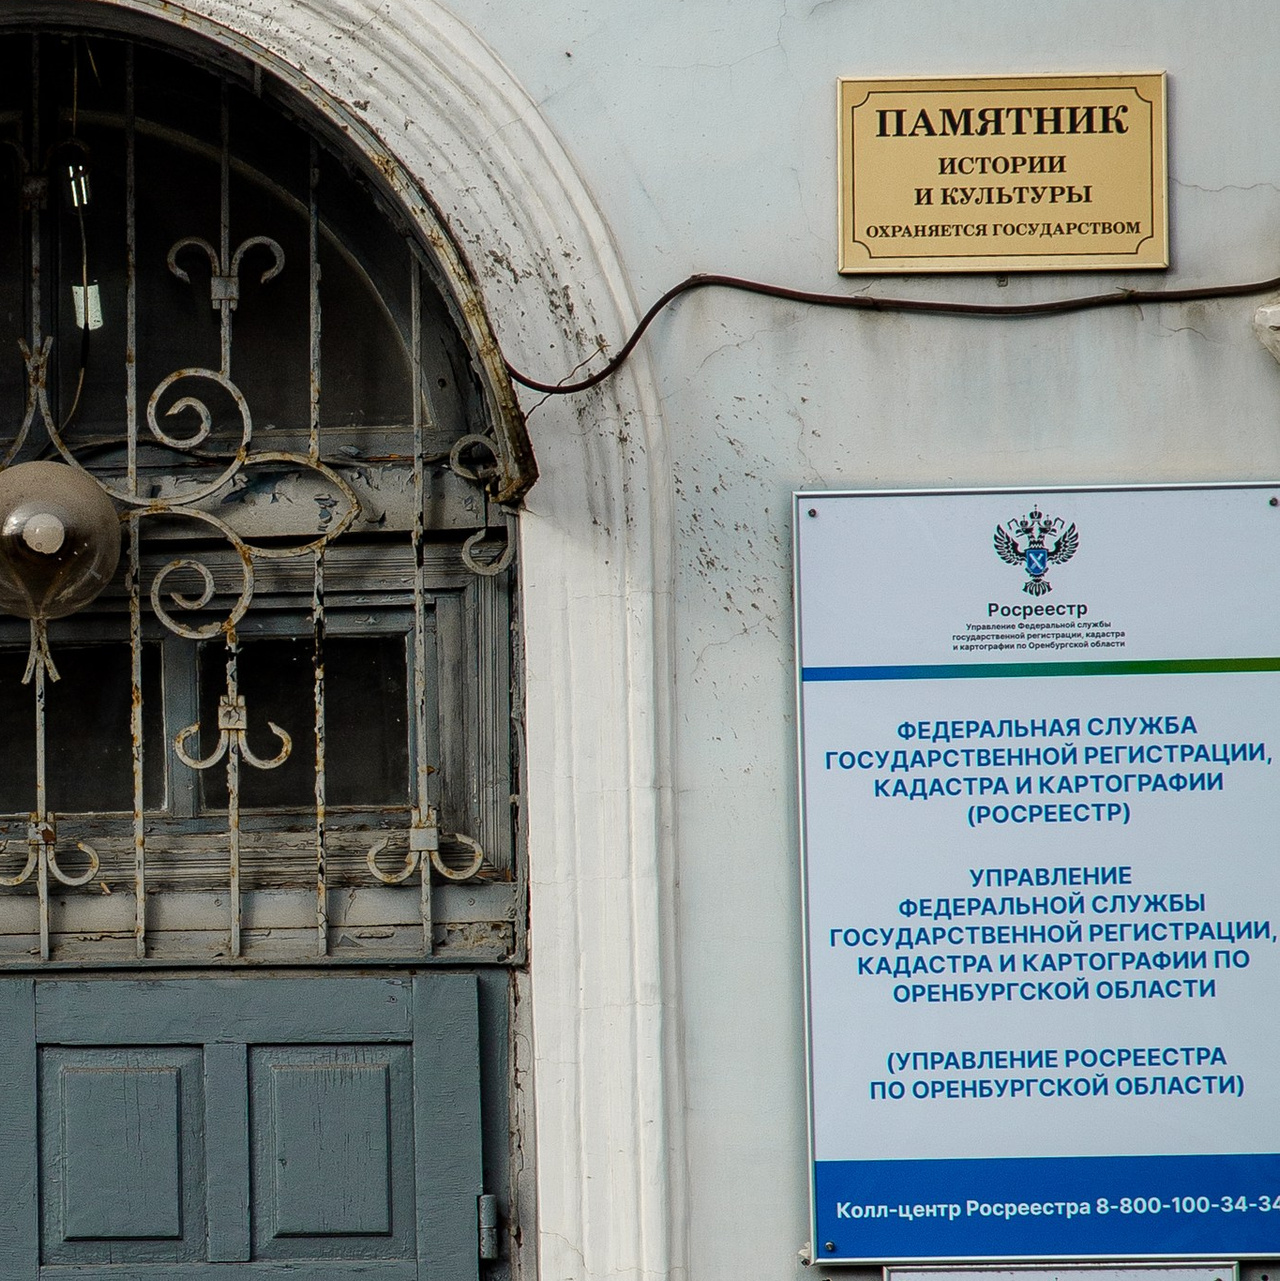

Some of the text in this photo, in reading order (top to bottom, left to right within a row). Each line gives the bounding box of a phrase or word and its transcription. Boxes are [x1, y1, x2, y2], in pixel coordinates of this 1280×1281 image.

[876, 105, 1129, 137] ПАМЯТНИК
[938, 156, 1066, 175] ИСТОРИИ
[914, 185, 1093, 205] И КУЛЬТУРЫ
[866, 222, 1141, 239] ОХРАНЯЕТСЯ ГОСУДАРСТВОМ
[987, 602, 1088, 619] Росреестр
[952, 632, 1025, 641] государственной
[1027, 631, 1084, 639] регистрации,
[966, 623, 1016, 631] Управление
[1018, 622, 1075, 630] Федеральной
[960, 642, 1014, 651] картографии
[1029, 641, 1088, 649] Оренбургской
[897, 716, 1198, 743] ФЕДЕРАЛЬНАЯ СЛУЖБА
[825, 742, 1272, 772] ГОСУДАРСТВЕННОЙ РЕГИСТРАЦИИ,
[874, 772, 1224, 800] КАДАСТРА И КАРТОГРАФИИ
[968, 802, 1131, 828] (РОСРЕЕСТР)
[969, 866, 1132, 888] УПРАВЛЕНИЕ
[898, 892, 1205, 920] ФЕДЕРАЛЬНОЙ СЛУЖБЫ
[830, 921, 1278, 949] ГОСУДАРСТВЕННОЙ РЕГИСТРАЦИИ,
[858, 949, 1250, 978] КАДАСТРА И КАРТОГРАФИИ ПО
[892, 978, 1216, 1003] ОРЕНБУРГСКОЙ ОБЛАСТИ
[887, 1047, 1227, 1075] (УПРАВЛЕНИЕ РОСРЕЕСТРА
[870, 1073, 1245, 1100] ПО ОРЕНБУРГСКОЙ ОБЛАСТИ)
[836, 1201, 961, 1220] Колл-центр
[966, 1198, 1091, 1219] Росреестра
